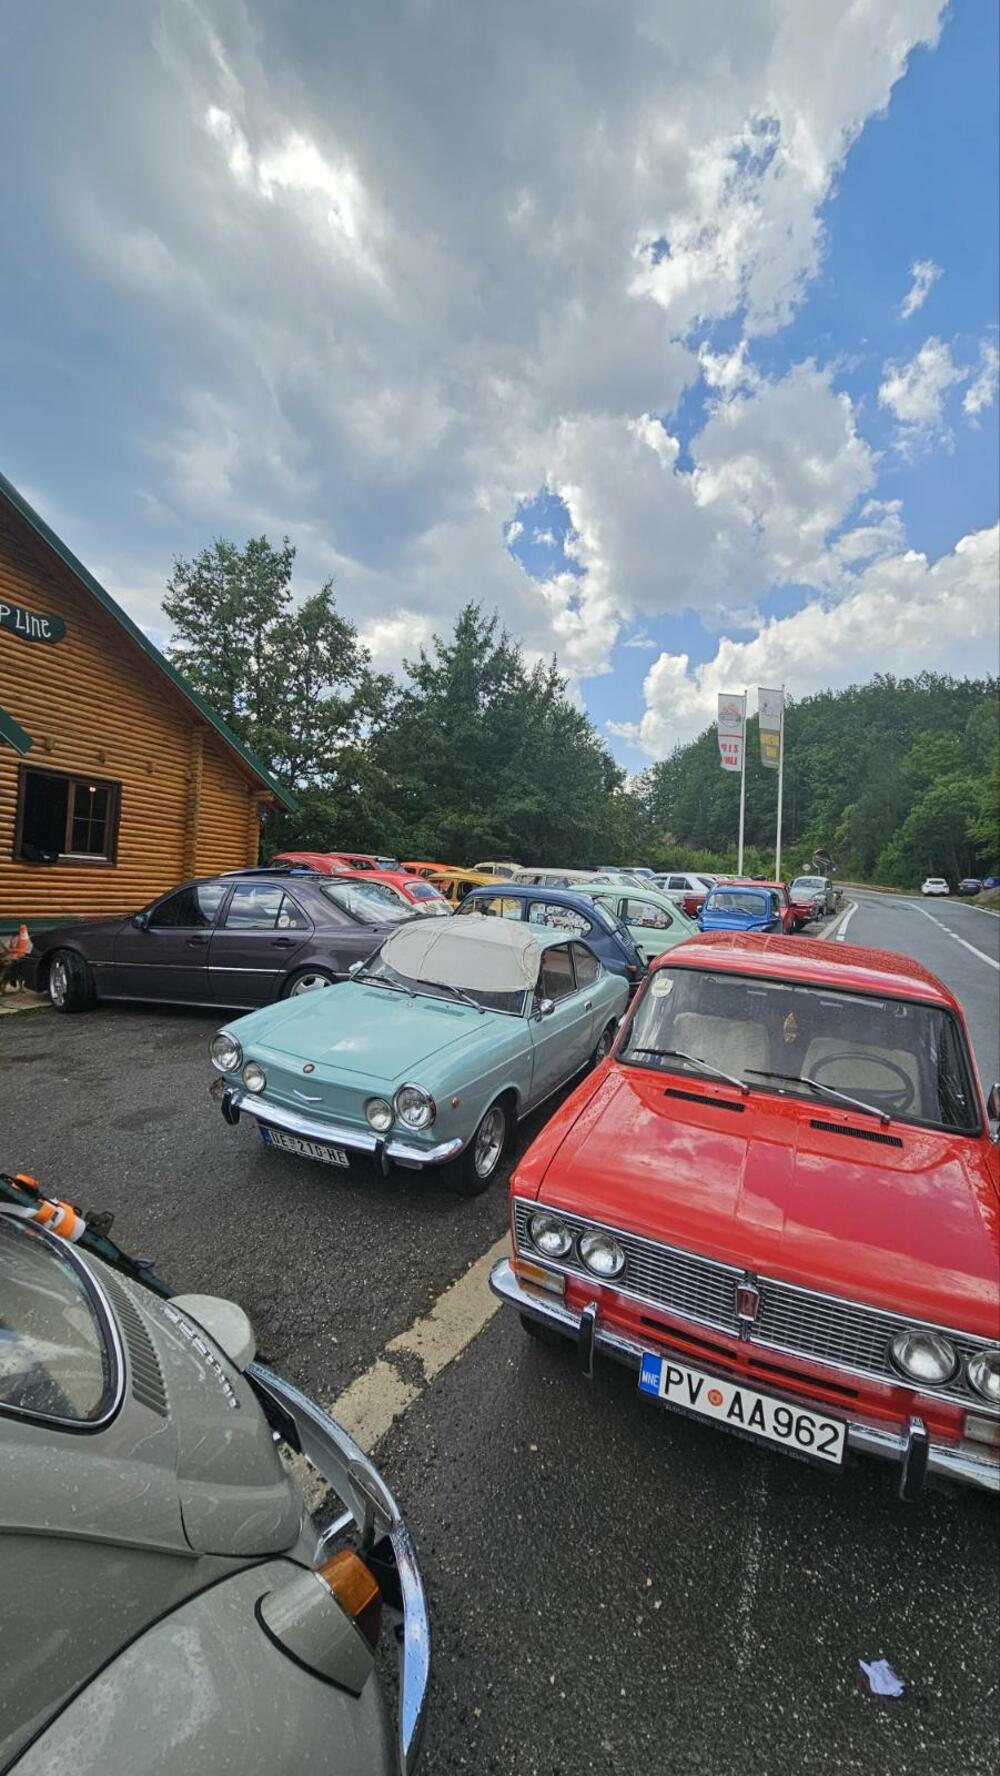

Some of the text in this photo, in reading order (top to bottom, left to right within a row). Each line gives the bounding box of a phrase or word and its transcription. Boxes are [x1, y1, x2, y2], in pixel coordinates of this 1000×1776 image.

[272, 1132, 288, 1147] UE
[642, 1370, 660, 1389] MNE
[664, 1365, 704, 1406] PV
[726, 1391, 840, 1459] AA962
